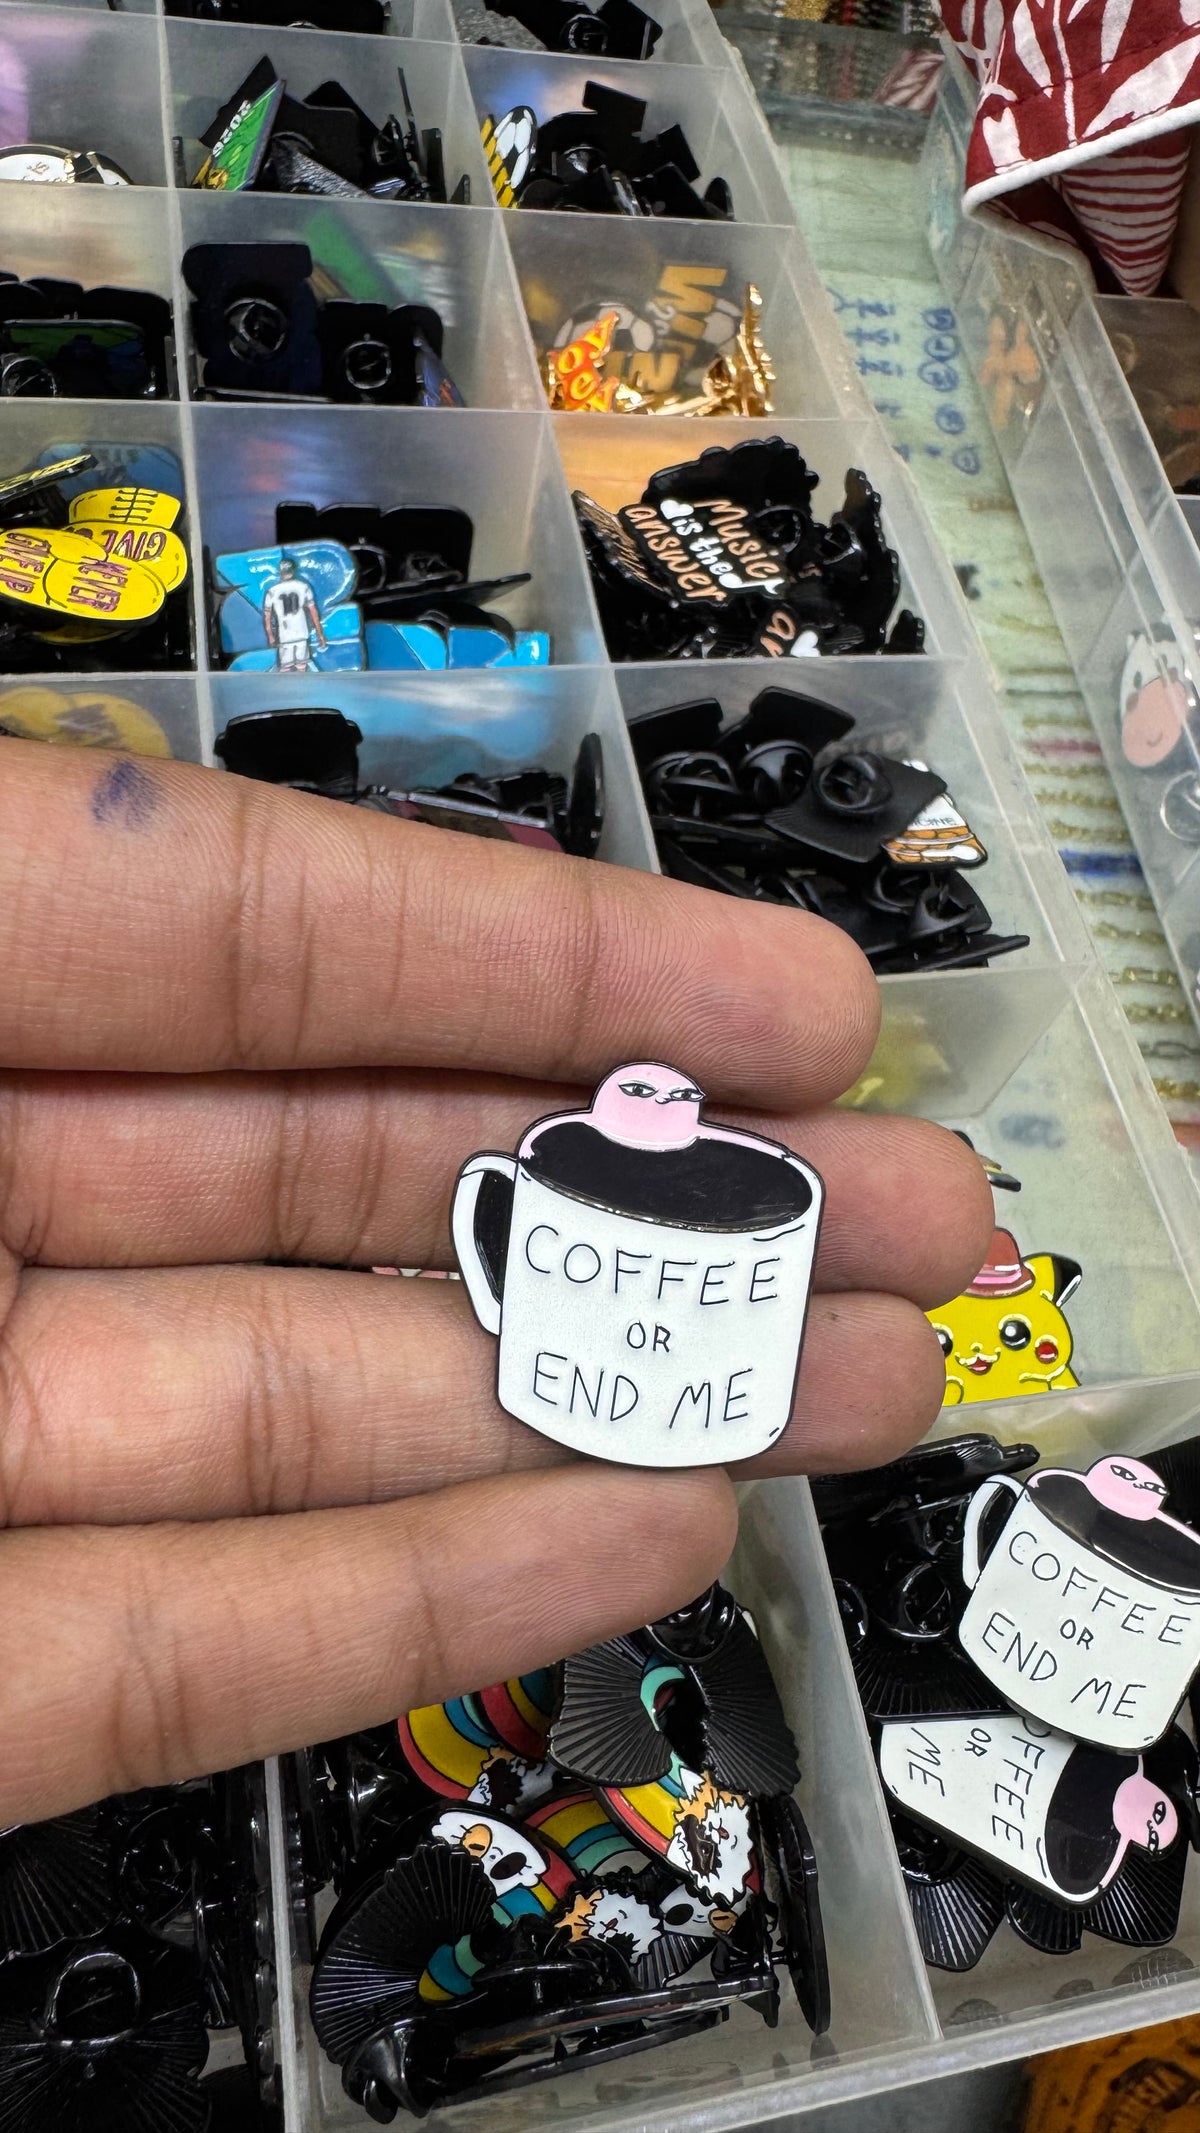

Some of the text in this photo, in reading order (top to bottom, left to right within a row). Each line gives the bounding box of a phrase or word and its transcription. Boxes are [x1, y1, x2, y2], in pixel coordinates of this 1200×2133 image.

[624, 506, 728, 601] answer
[671, 518, 734, 576] is the
[693, 499, 780, 579] Music
[525, 1224, 781, 1306] COFFEE
[626, 1321, 671, 1353] OR
[533, 1351, 753, 1430] END ME
[1008, 1531, 1192, 1646] COFFEE
[982, 1611, 1147, 1719] END ME
[1059, 1618, 1095, 1651] OR
[906, 1726, 946, 1797] ME
[964, 1727, 993, 1758] OR
[991, 1716, 1051, 1851] FFEE
